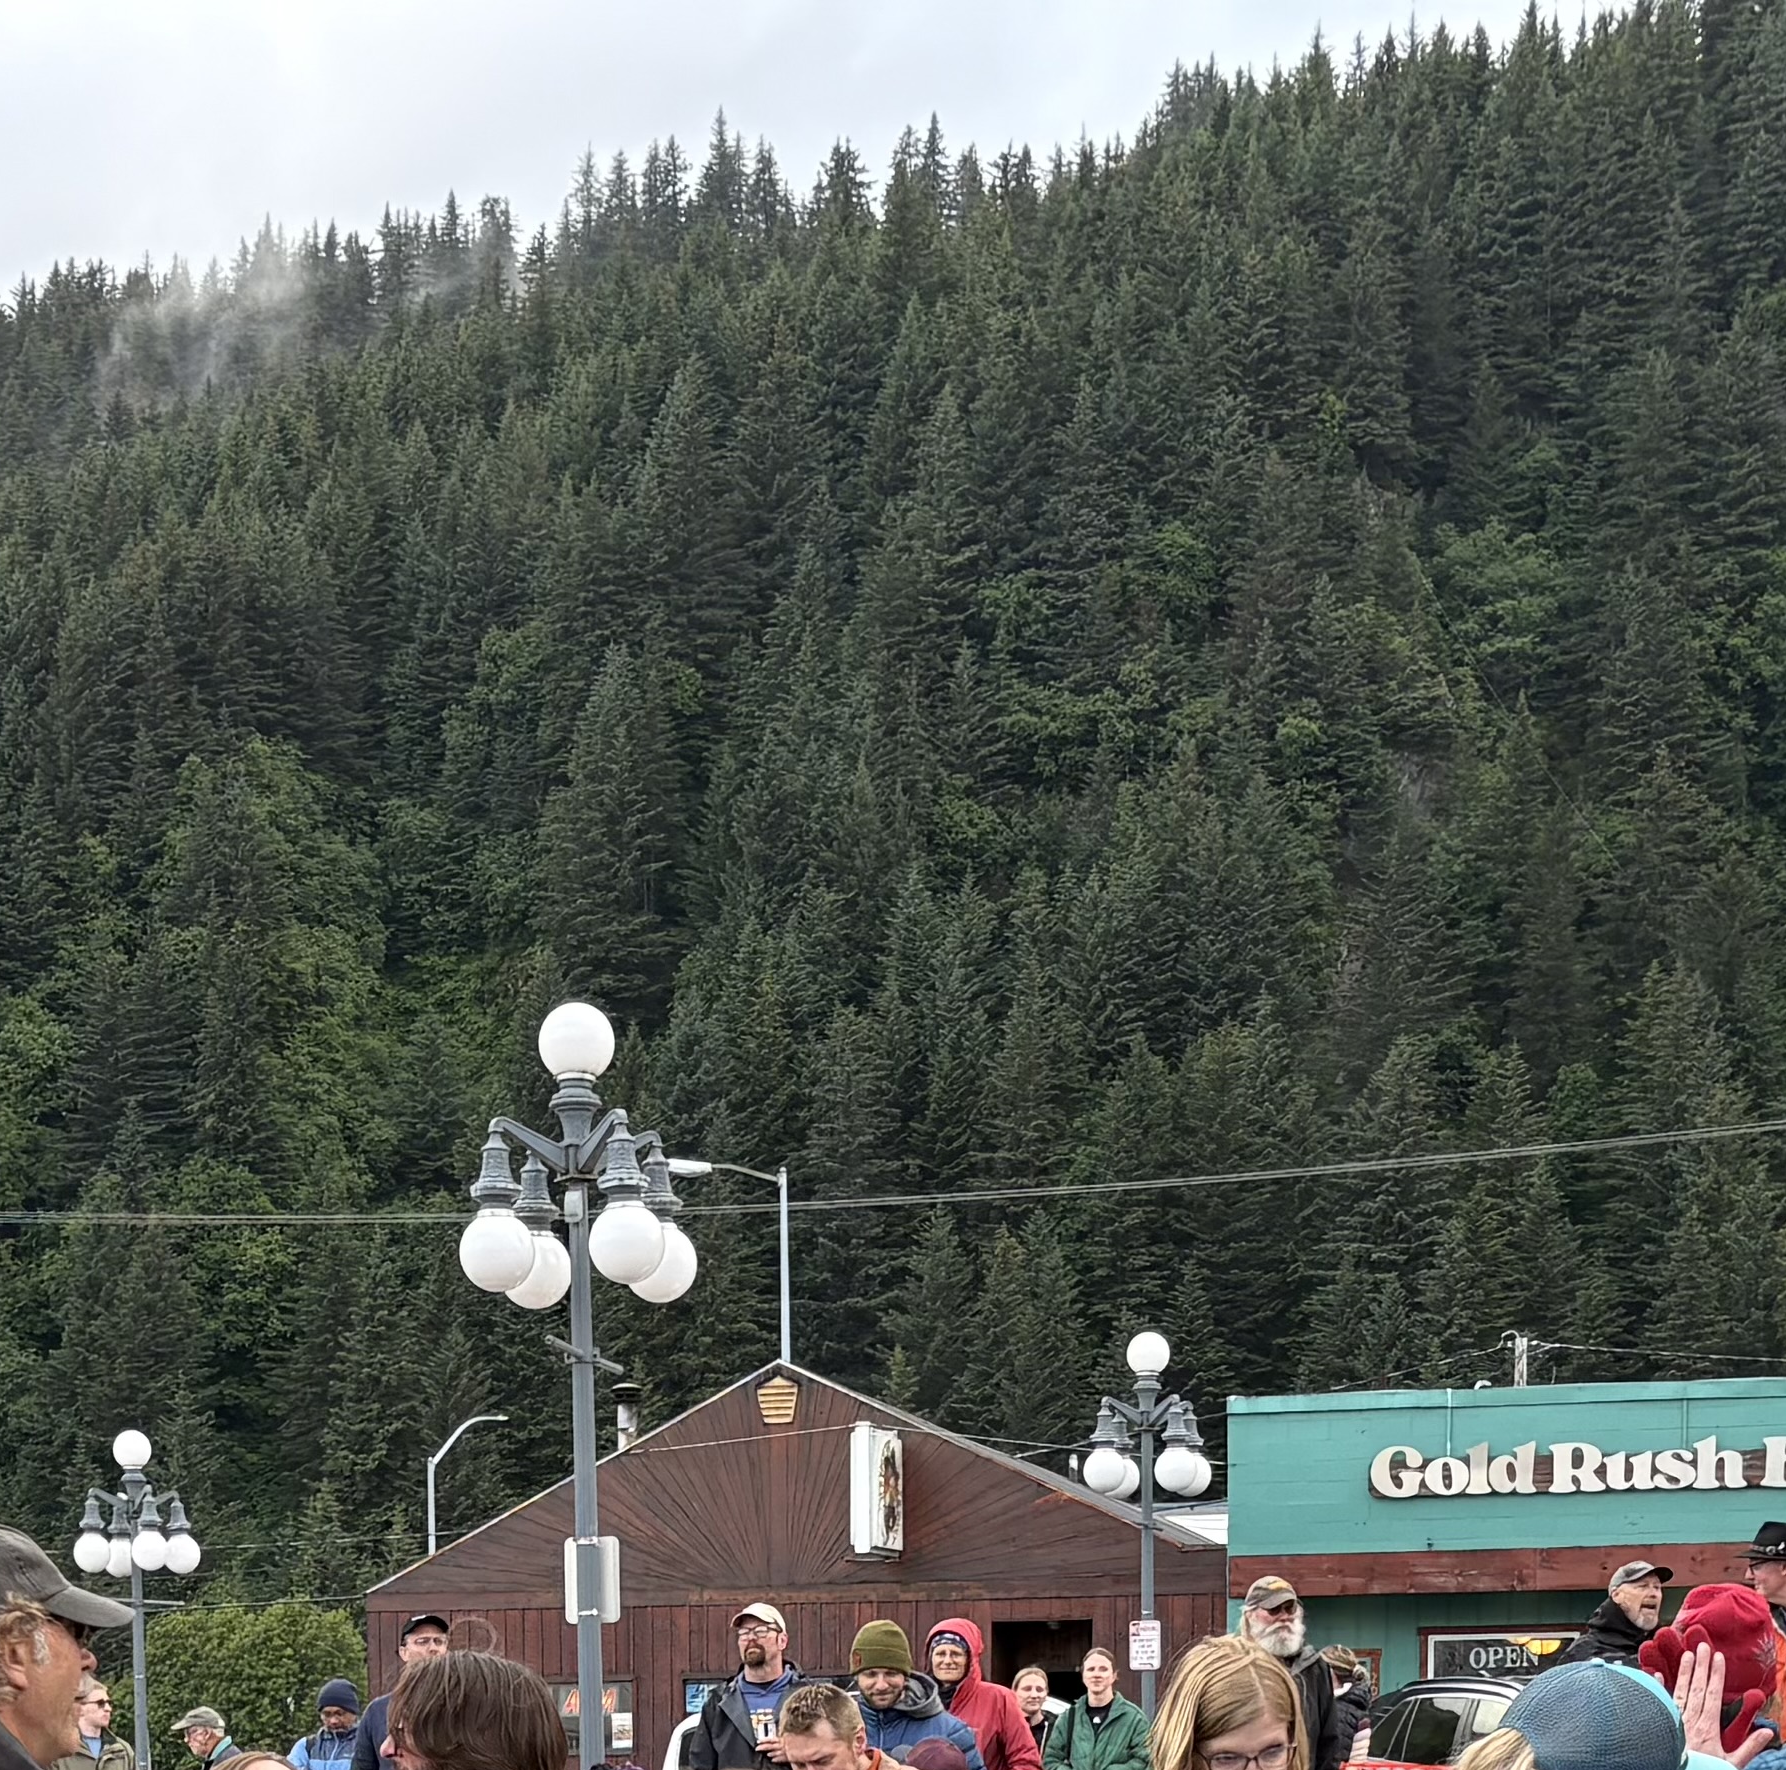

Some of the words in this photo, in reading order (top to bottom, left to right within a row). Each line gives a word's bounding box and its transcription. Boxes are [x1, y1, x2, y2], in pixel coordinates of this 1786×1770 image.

[1369, 1440, 1537, 1499] Gold
[1547, 1435, 1749, 1493] Rush
[1469, 1646, 1538, 1669] OPEN
